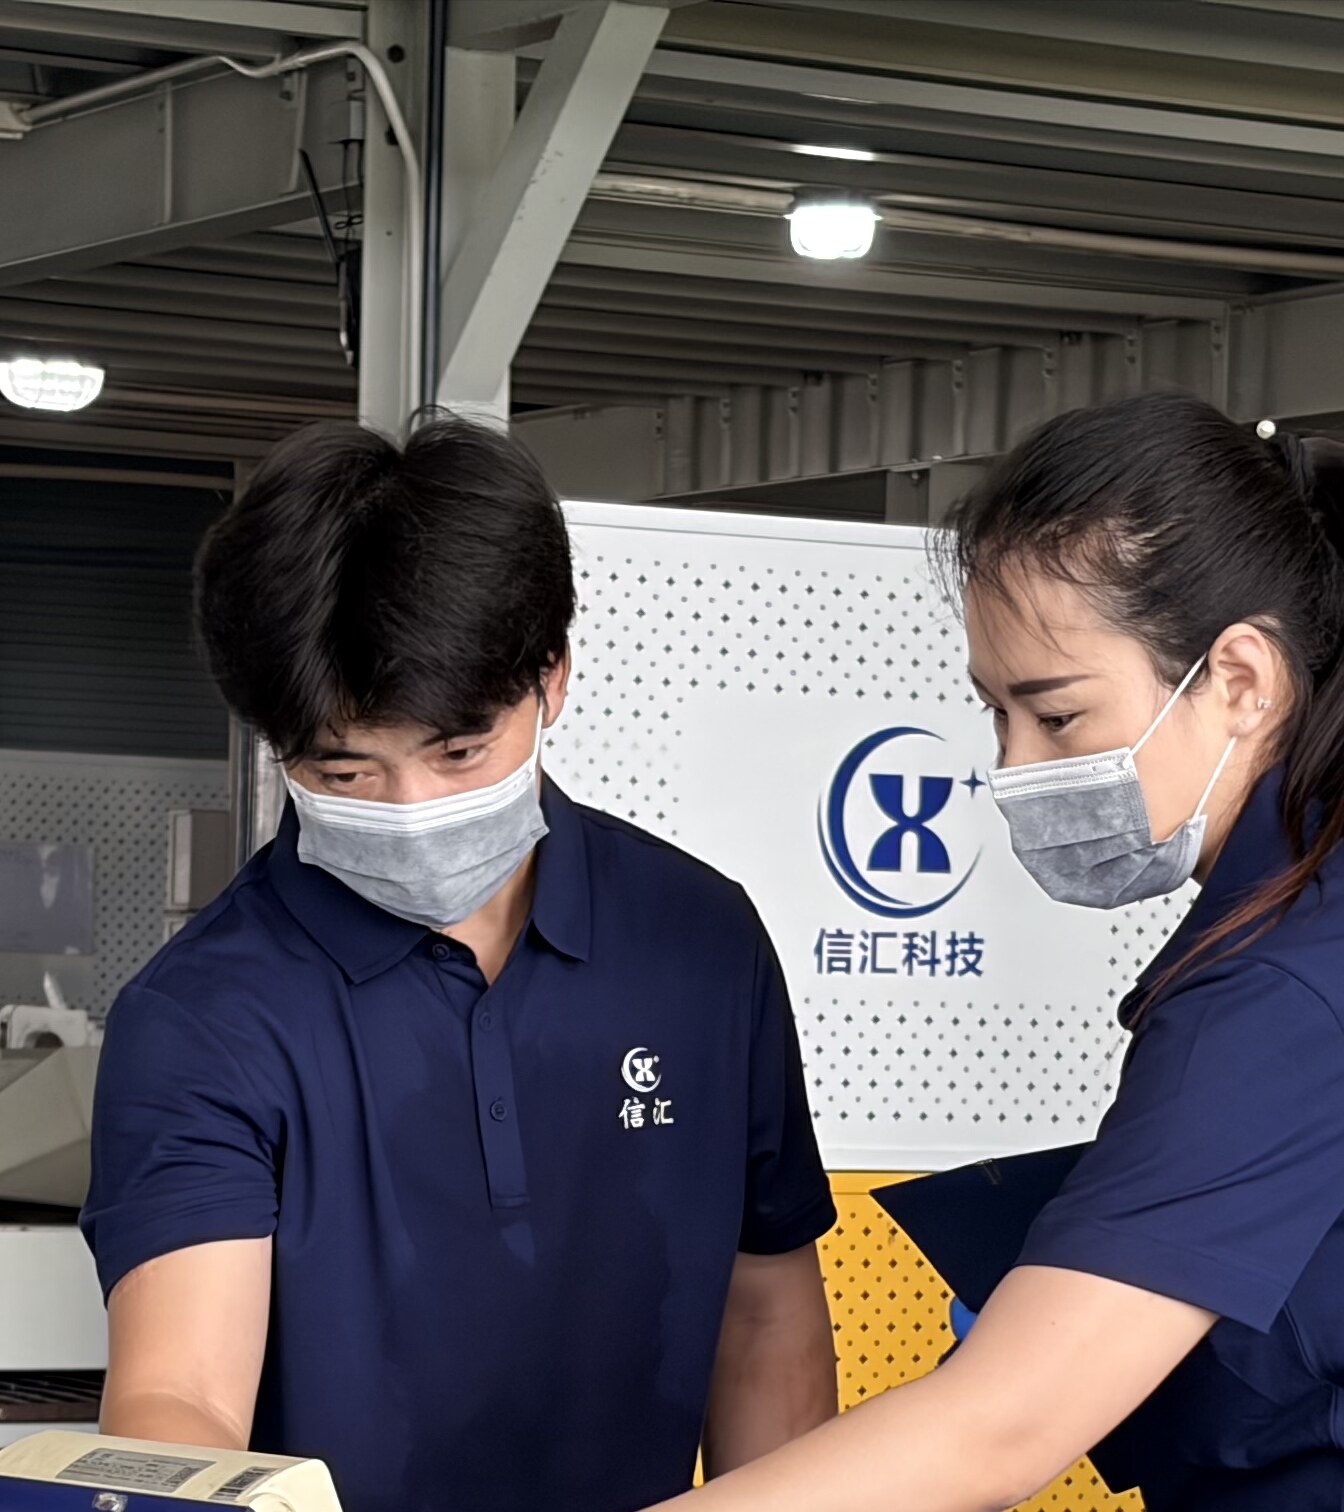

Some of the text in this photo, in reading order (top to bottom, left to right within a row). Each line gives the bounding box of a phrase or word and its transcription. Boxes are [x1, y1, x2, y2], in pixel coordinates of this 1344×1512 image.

[813, 927, 986, 978] 信汇科技
[618, 1096, 675, 1130] 信汇
